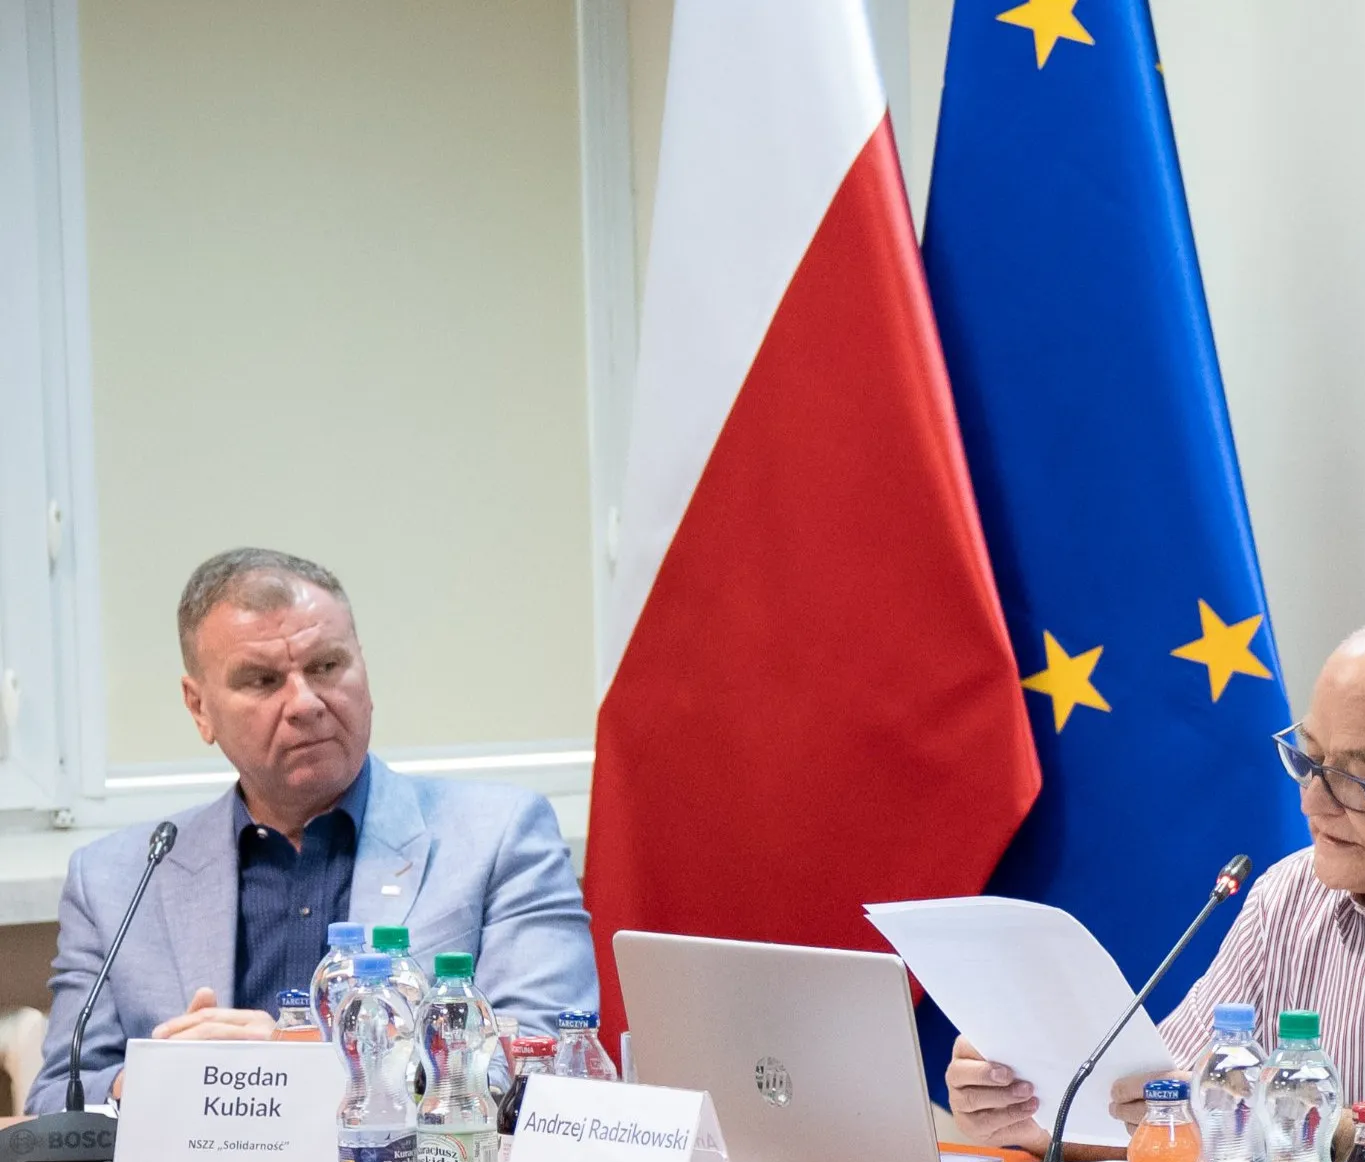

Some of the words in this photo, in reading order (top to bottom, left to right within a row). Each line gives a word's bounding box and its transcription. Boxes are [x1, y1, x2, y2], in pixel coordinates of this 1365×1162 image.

[203, 1066, 288, 1090] Bogdan
[1145, 1089, 1179, 1099] TARCZYN
[203, 1097, 282, 1118] Kubiak
[48, 1129, 117, 1150] BOSC
[523, 1111, 587, 1142] Andrzej
[588, 1118, 690, 1151] Radzikowski
[188, 1139, 215, 1149] NSZZ
